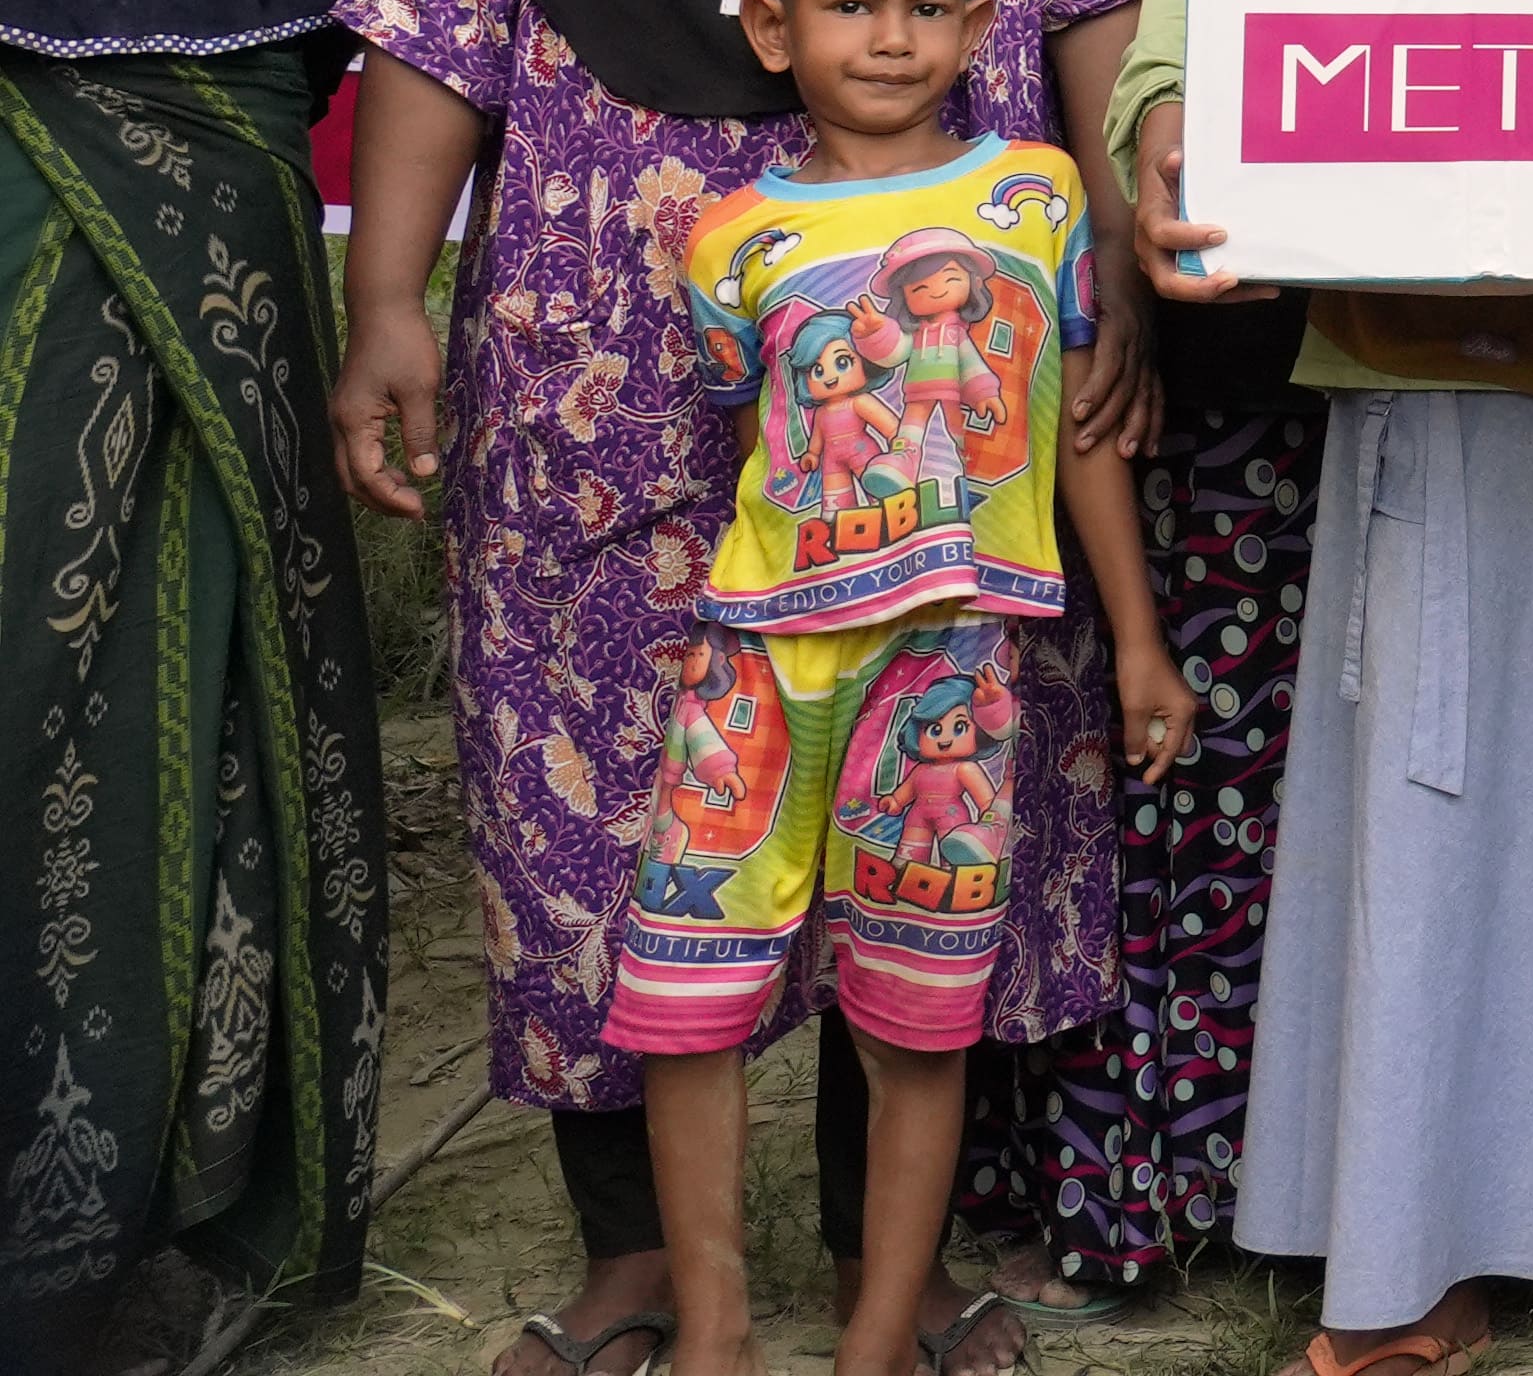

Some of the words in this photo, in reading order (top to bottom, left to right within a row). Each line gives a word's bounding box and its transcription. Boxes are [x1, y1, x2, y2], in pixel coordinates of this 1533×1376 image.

[778, 579, 857, 613] ENJOY
[870, 550, 927, 588] YOUR
[1011, 575, 1067, 602] LIFE
[920, 928, 992, 952] YOUR
